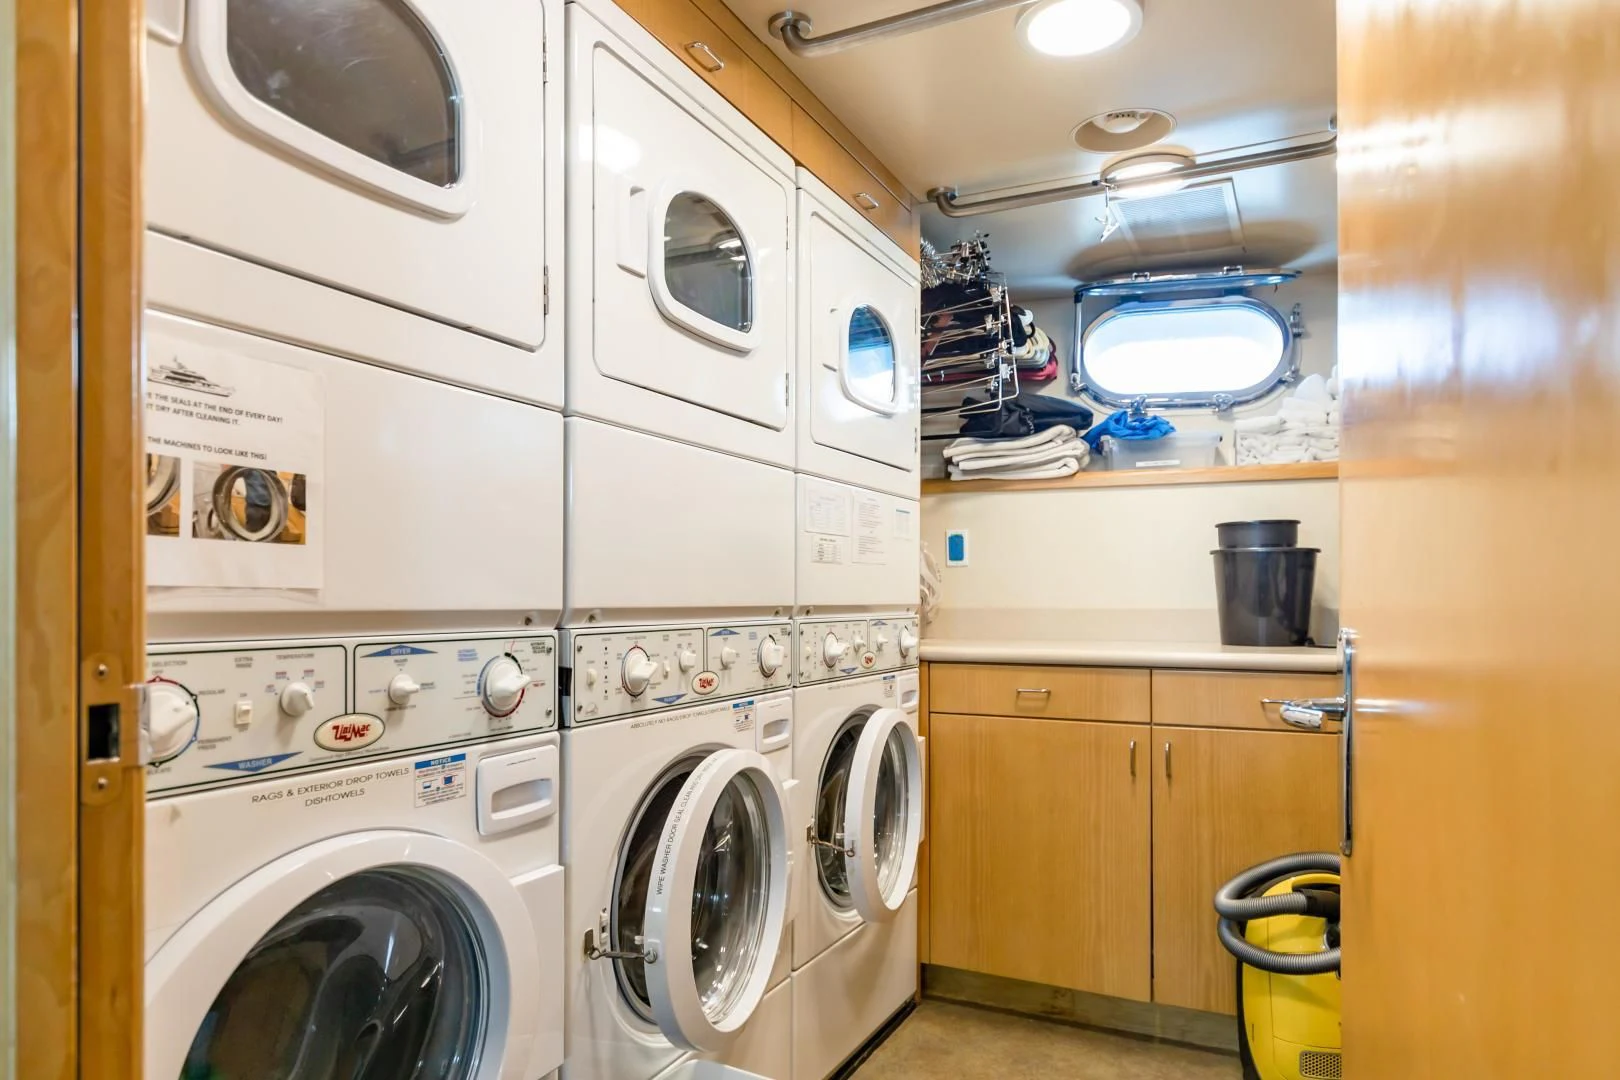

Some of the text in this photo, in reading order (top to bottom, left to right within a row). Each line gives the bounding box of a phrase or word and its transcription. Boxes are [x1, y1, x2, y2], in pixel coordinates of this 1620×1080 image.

[155, 393, 168, 402] THE
[171, 396, 191, 406] SEALS
[204, 403, 216, 412] THE
[219, 406, 234, 415] END
[245, 410, 266, 420] EVERY
[267, 416, 283, 424] DAY!
[155, 404, 170, 412] DRY
[172, 408, 194, 418] AFTER
[196, 411, 231, 424] CLEANING
[148, 436, 267, 460] THE MACHINES TO LOOK LIKE THIS!
[238, 757, 272, 770] WASHER
[430, 756, 452, 766] NOTICE
[251, 767, 410, 804] RAGS & EXTERIOR DROP TOWELS
[304, 788, 366, 807] DISHTOWELS
[681, 789, 692, 807] CLEAN
[674, 808, 684, 825] SEAL
[668, 824, 678, 842] DOOR
[660, 844, 673, 875] WASHER
[656, 876, 665, 896] WIPE
